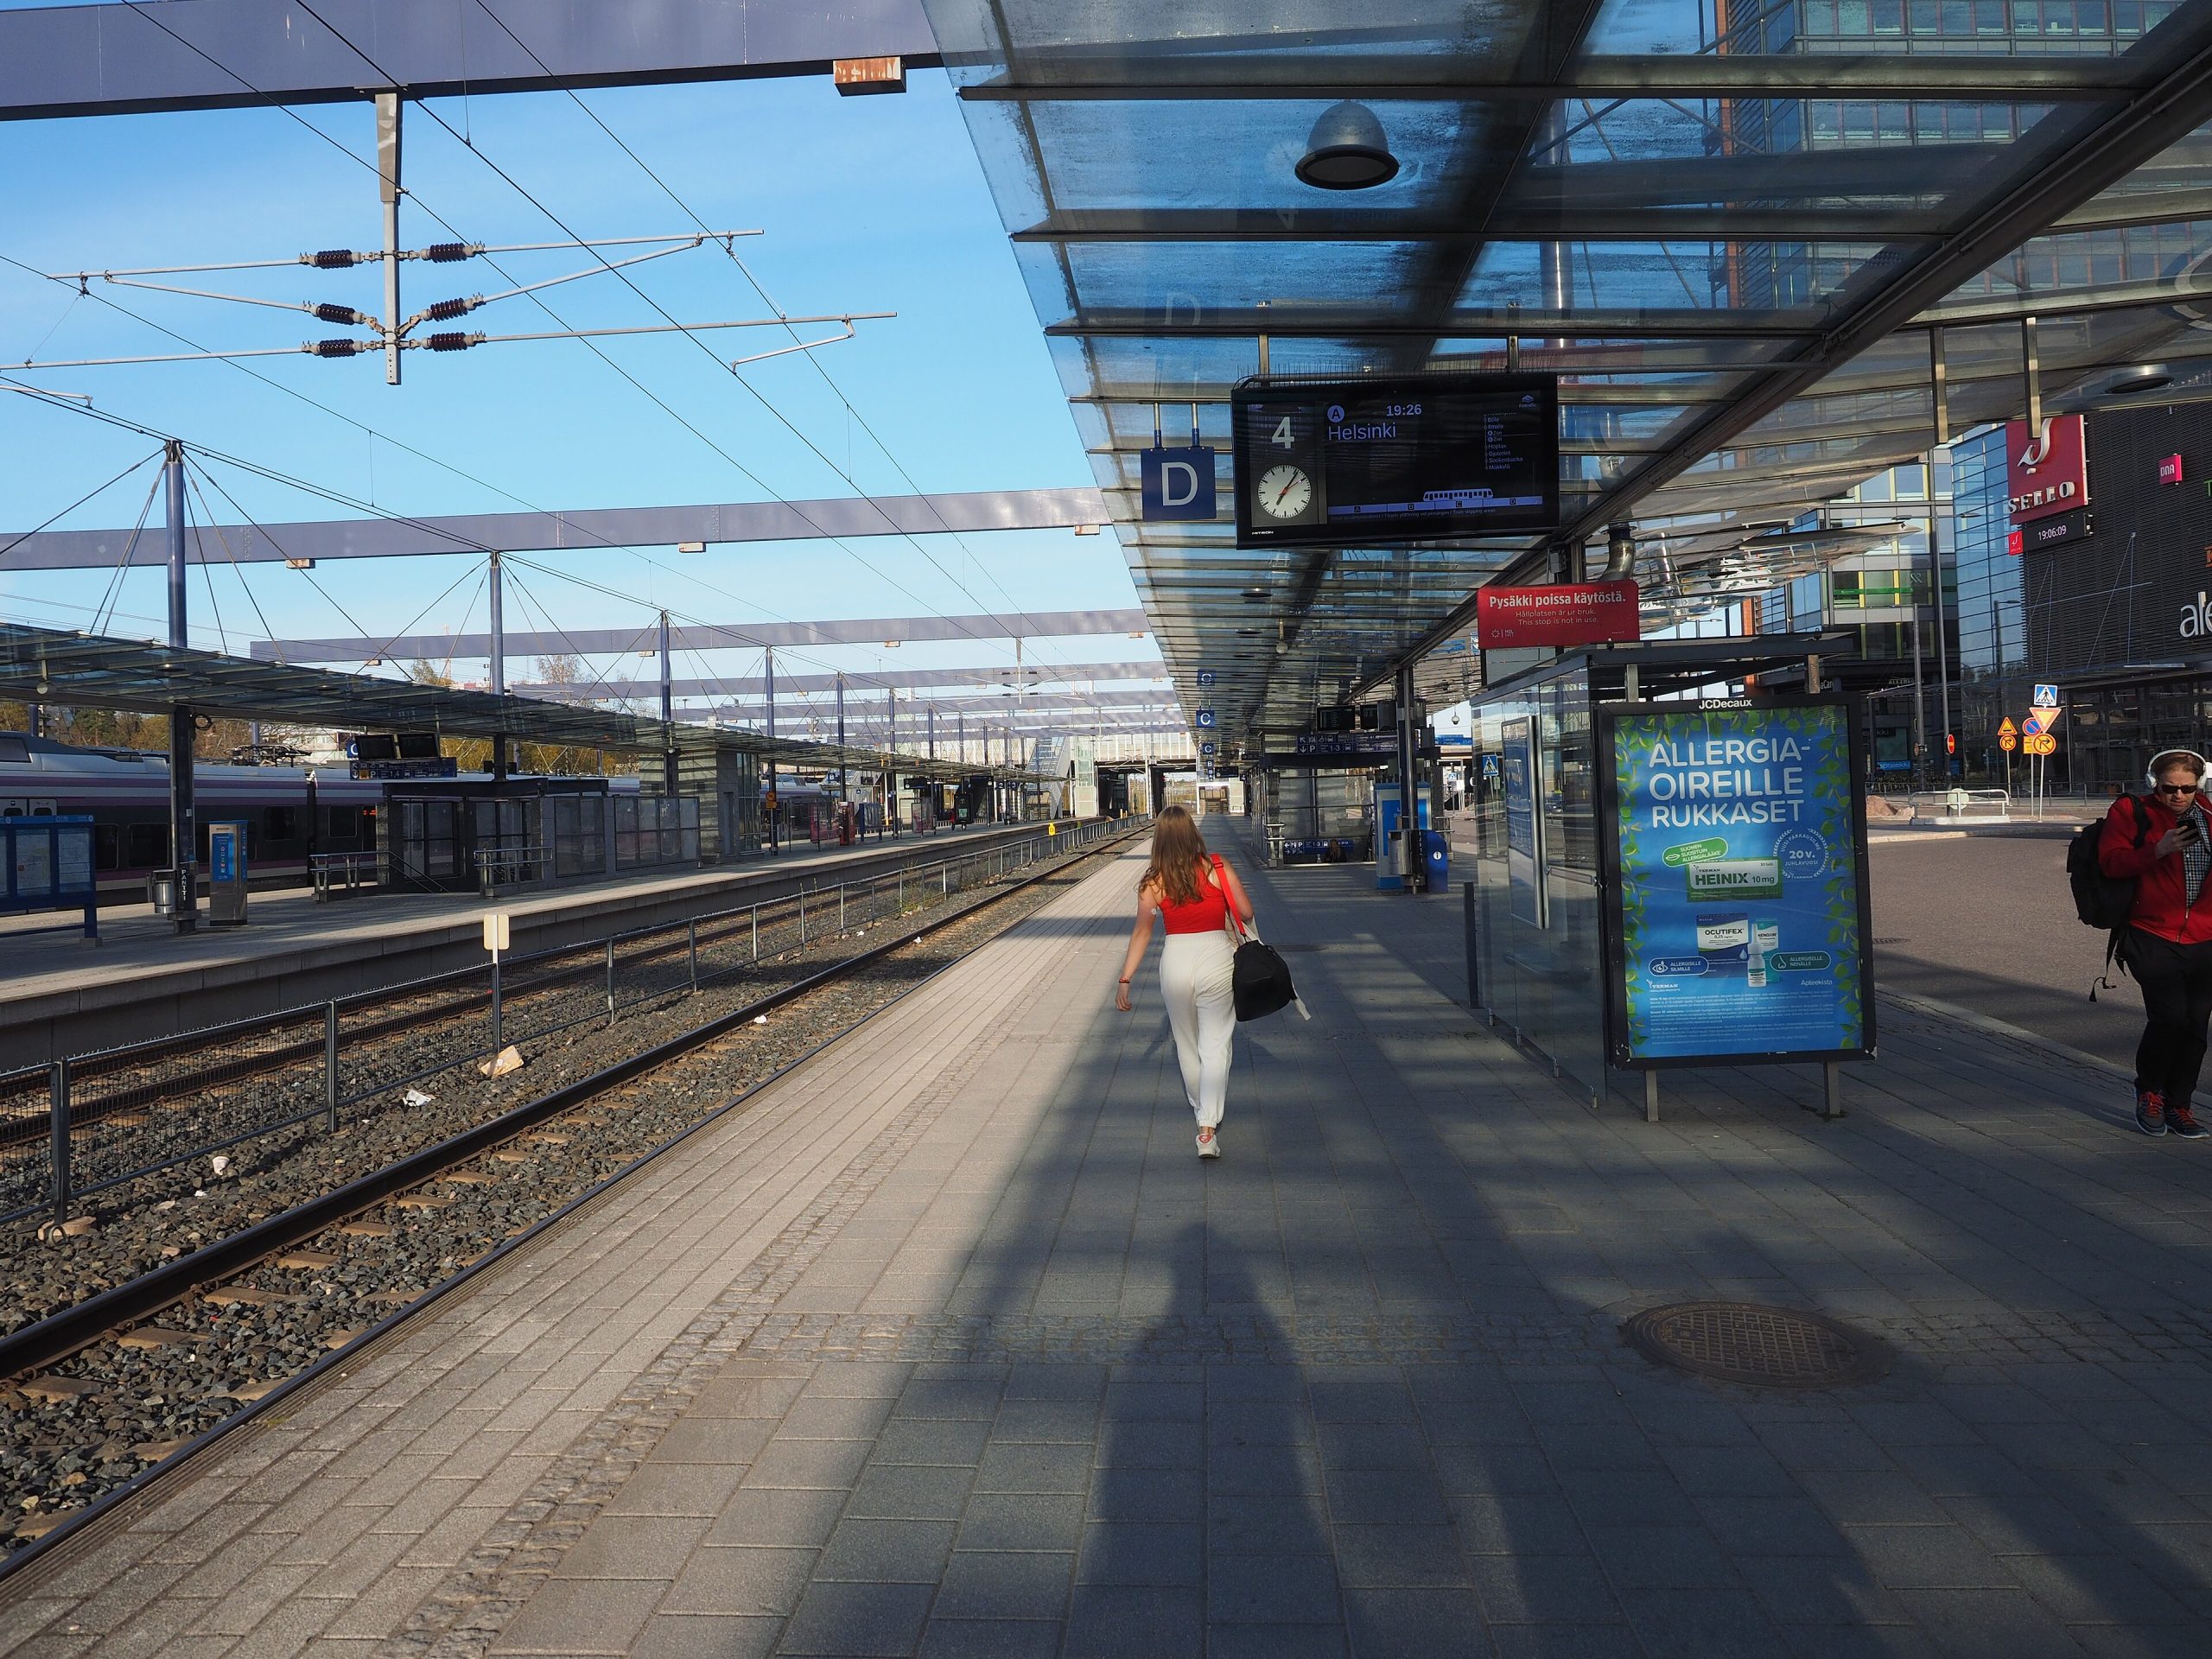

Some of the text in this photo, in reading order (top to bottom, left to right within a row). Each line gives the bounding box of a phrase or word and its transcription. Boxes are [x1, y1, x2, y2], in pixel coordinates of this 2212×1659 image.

[1386, 404, 1422, 416] 19:26
[1271, 416, 1295, 449] 4
[1328, 422, 1396, 441] Helsinki
[2160, 463, 2176, 477] DNA
[1160, 461, 1198, 506] D
[2007, 481, 2075, 514] SELLO
[2037, 524, 2067, 541] 19:06:09
[1489, 590, 1626, 609] Pysäkki poissa käytöstä.
[1516, 608, 1557, 618] Hållplatsen
[1535, 618, 1552, 626] stop
[1699, 697, 1752, 710] JCDecaux
[1200, 713, 1211, 725] C
[1649, 737, 1811, 769] ALLERGIA-
[1649, 767, 1804, 801] OIREILLE
[1652, 799, 1803, 829] RUKKASET
[1680, 843, 1702, 853] SUOMEN
[1681, 848, 1708, 858] SUOSITUIN
[1789, 850, 1804, 859] 20
[1695, 873, 1749, 886] HEINIX
[1762, 876, 1775, 885] mg
